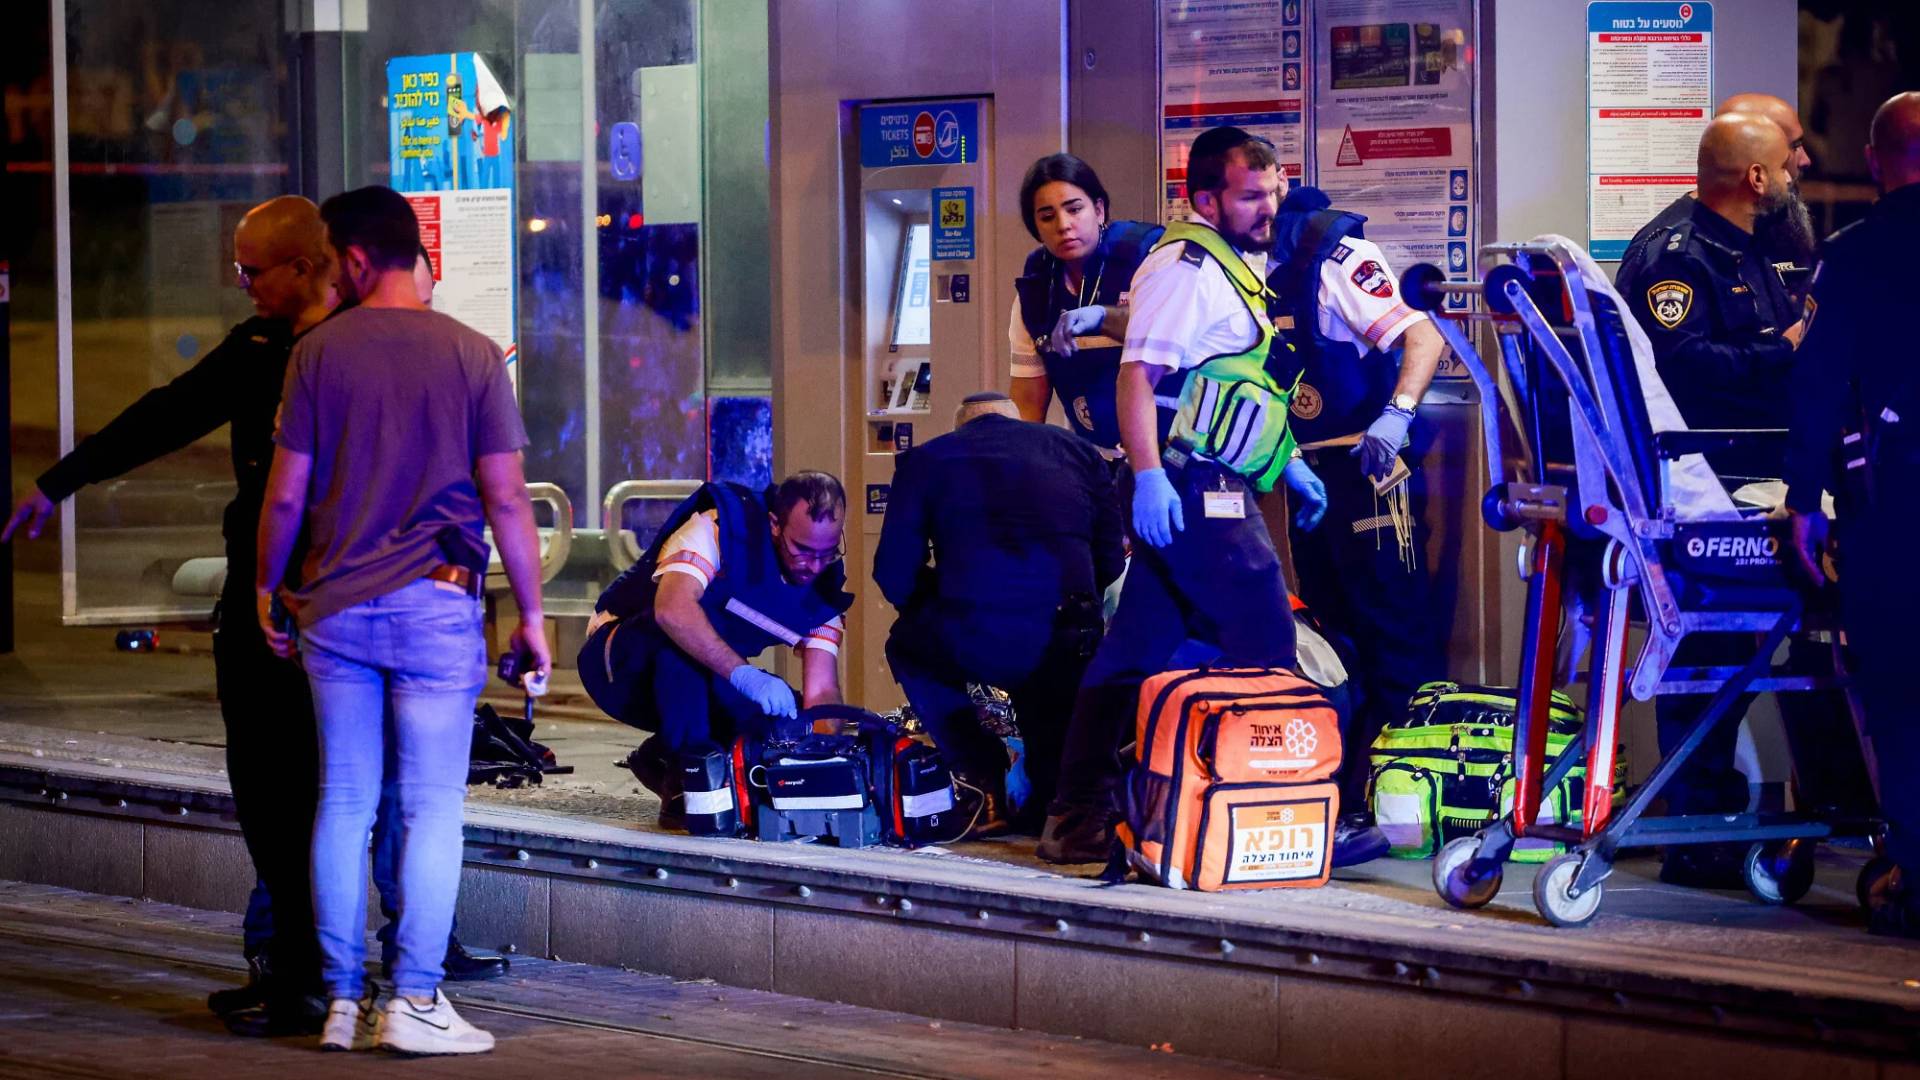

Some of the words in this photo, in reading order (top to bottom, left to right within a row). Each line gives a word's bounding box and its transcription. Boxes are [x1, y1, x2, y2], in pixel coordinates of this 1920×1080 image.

[1612, 19, 1636, 29] בטוח
[1637, 16, 1650, 29] על
[1653, 19, 1683, 29] נוסעים
[880, 114, 909, 126] כרטיסים
[881, 129, 909, 141] TICKETS
[1706, 537, 1778, 557] FERNO
[1250, 724, 1282, 735] איחוד
[1250, 736, 1282, 747] הצלה
[1245, 827, 1313, 853] רופא
[1243, 853, 1275, 863] הצלה
[1281, 850, 1313, 861] איחוד
